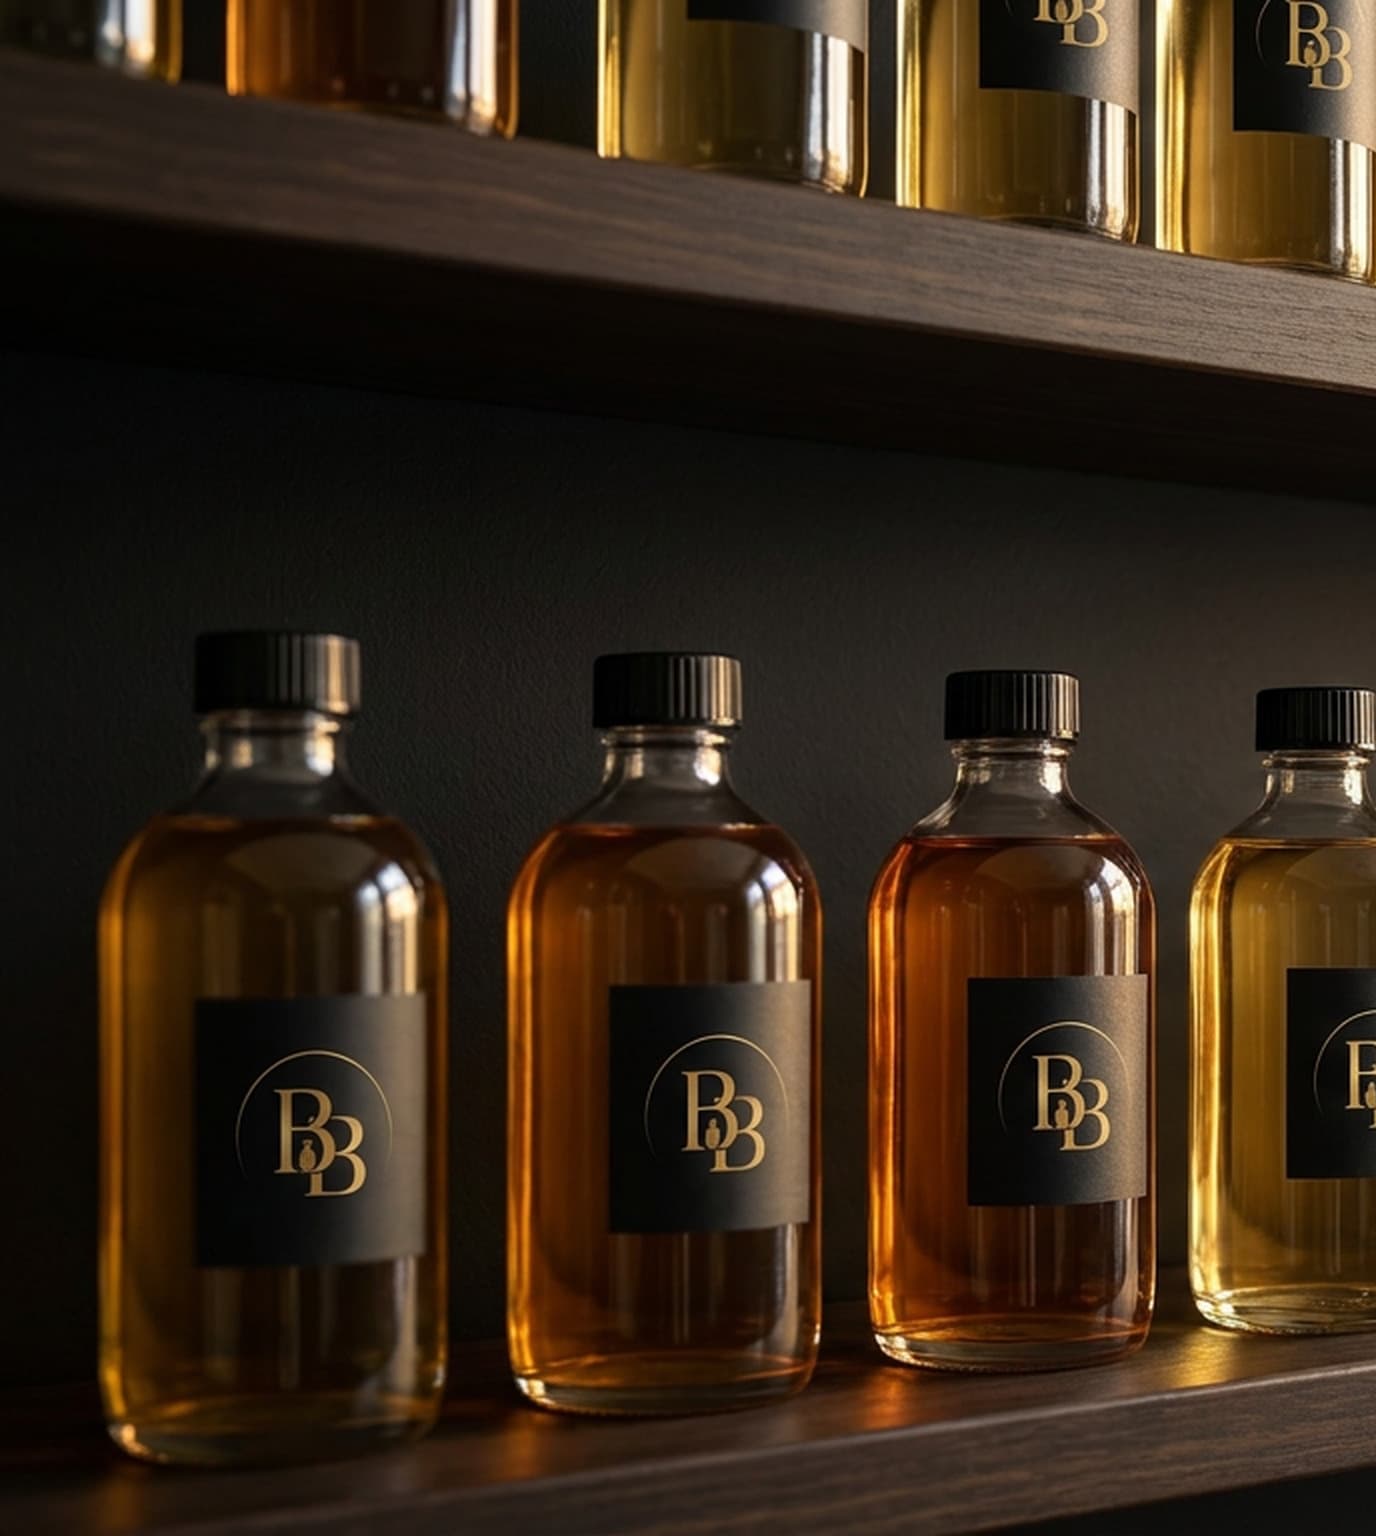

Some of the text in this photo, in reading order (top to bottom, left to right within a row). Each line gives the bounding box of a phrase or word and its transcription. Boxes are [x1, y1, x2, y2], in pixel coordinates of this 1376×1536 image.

[1285, 0, 1352, 91] BB
[274, 1087, 367, 1197] BB
[681, 1069, 765, 1172] BB
[1032, 1054, 1110, 1151] BB
